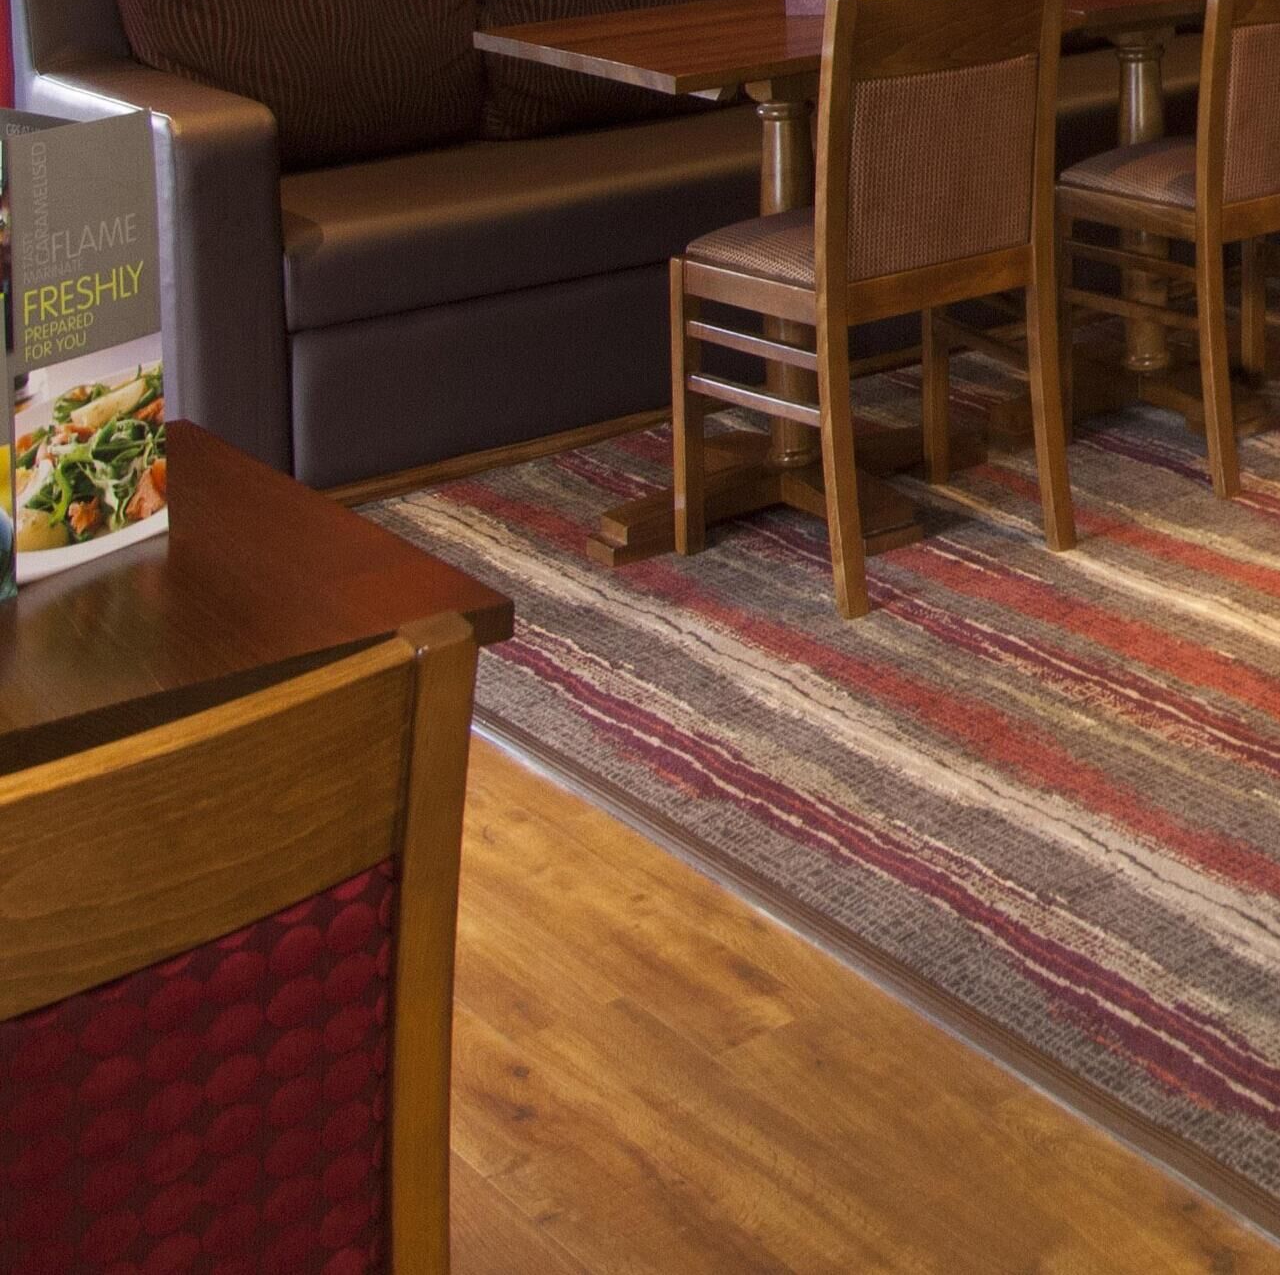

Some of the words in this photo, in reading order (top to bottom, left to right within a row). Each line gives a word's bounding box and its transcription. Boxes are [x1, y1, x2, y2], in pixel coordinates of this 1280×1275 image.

[51, 212, 137, 264] FLAME
[23, 260, 144, 327] FRESHLY
[24, 311, 94, 344] PREPARED
[24, 341, 53, 363] FOR
[56, 332, 87, 353] YOU
